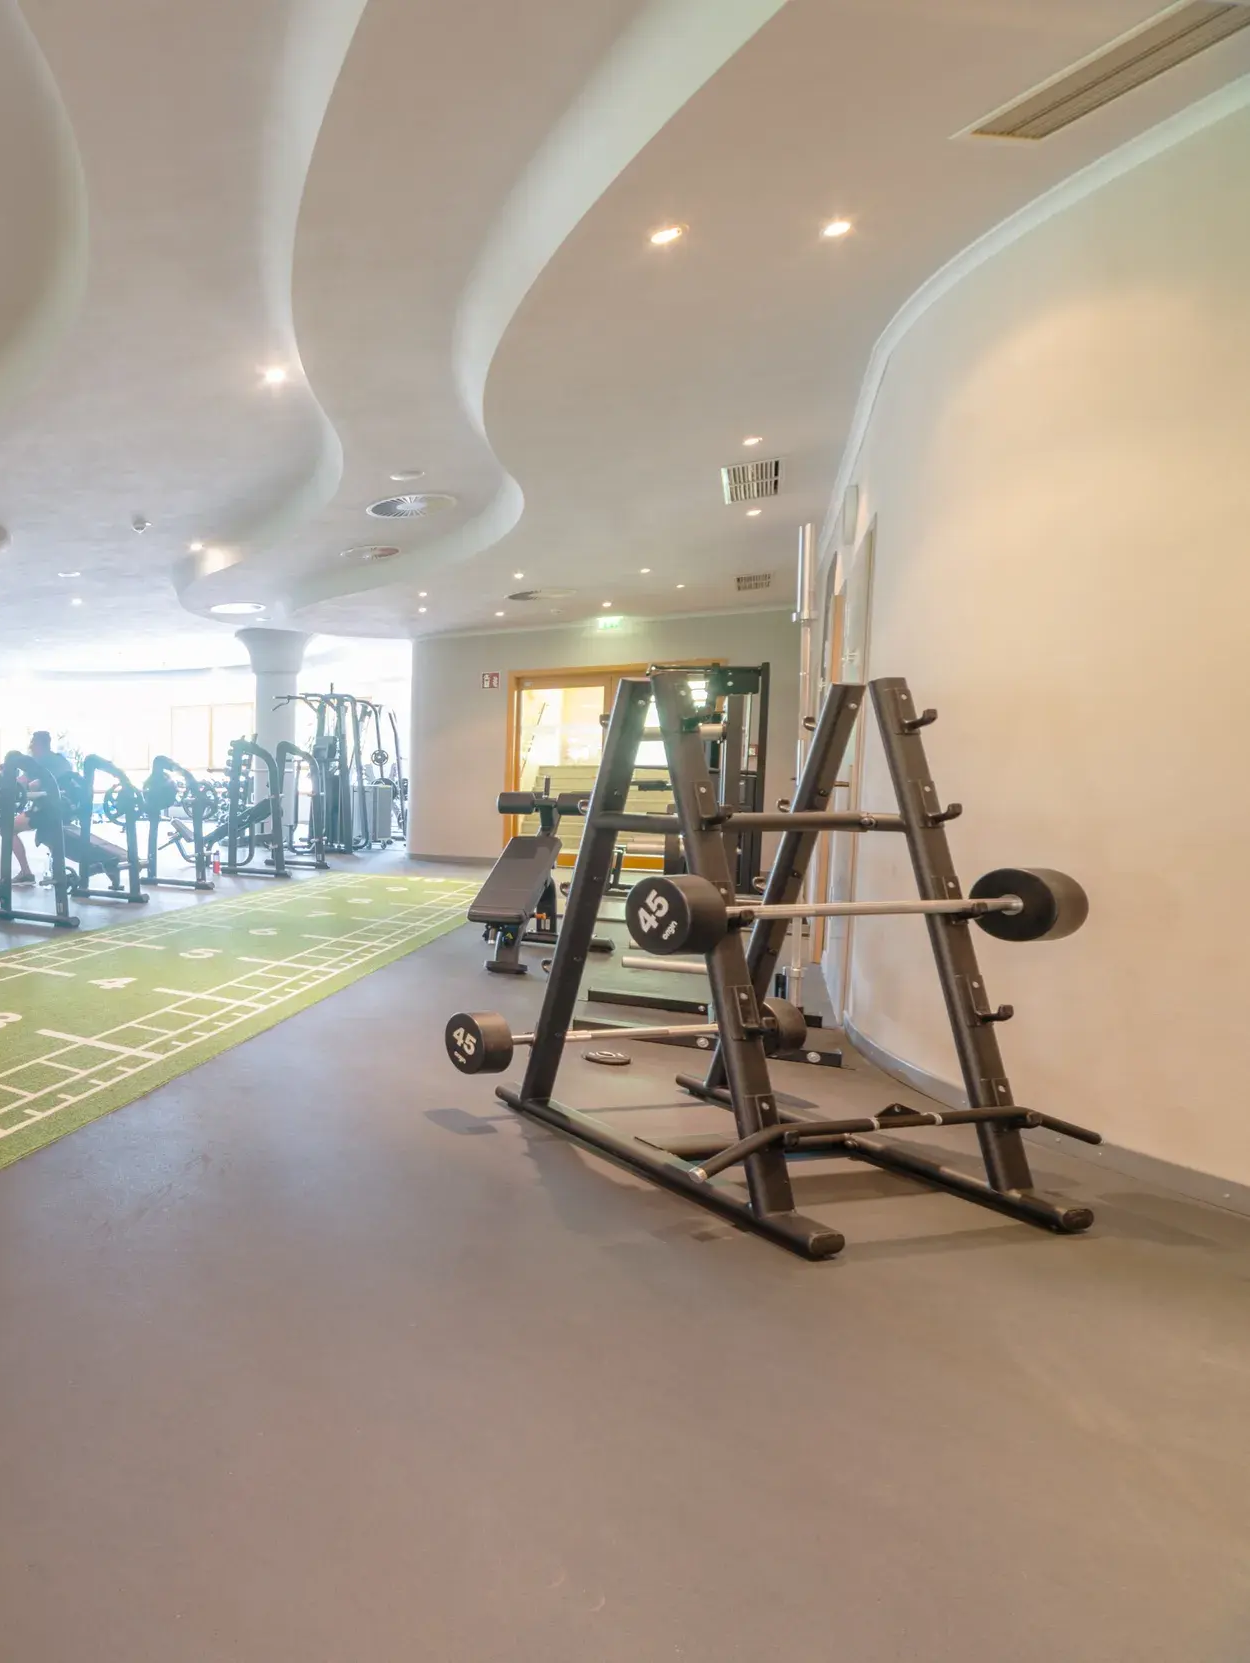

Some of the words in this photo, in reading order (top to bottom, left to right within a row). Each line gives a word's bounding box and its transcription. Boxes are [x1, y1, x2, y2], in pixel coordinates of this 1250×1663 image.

[638, 889, 669, 933] 45
[179, 948, 223, 960] 5
[88, 977, 138, 990] 4
[452, 1027, 477, 1056] 45
